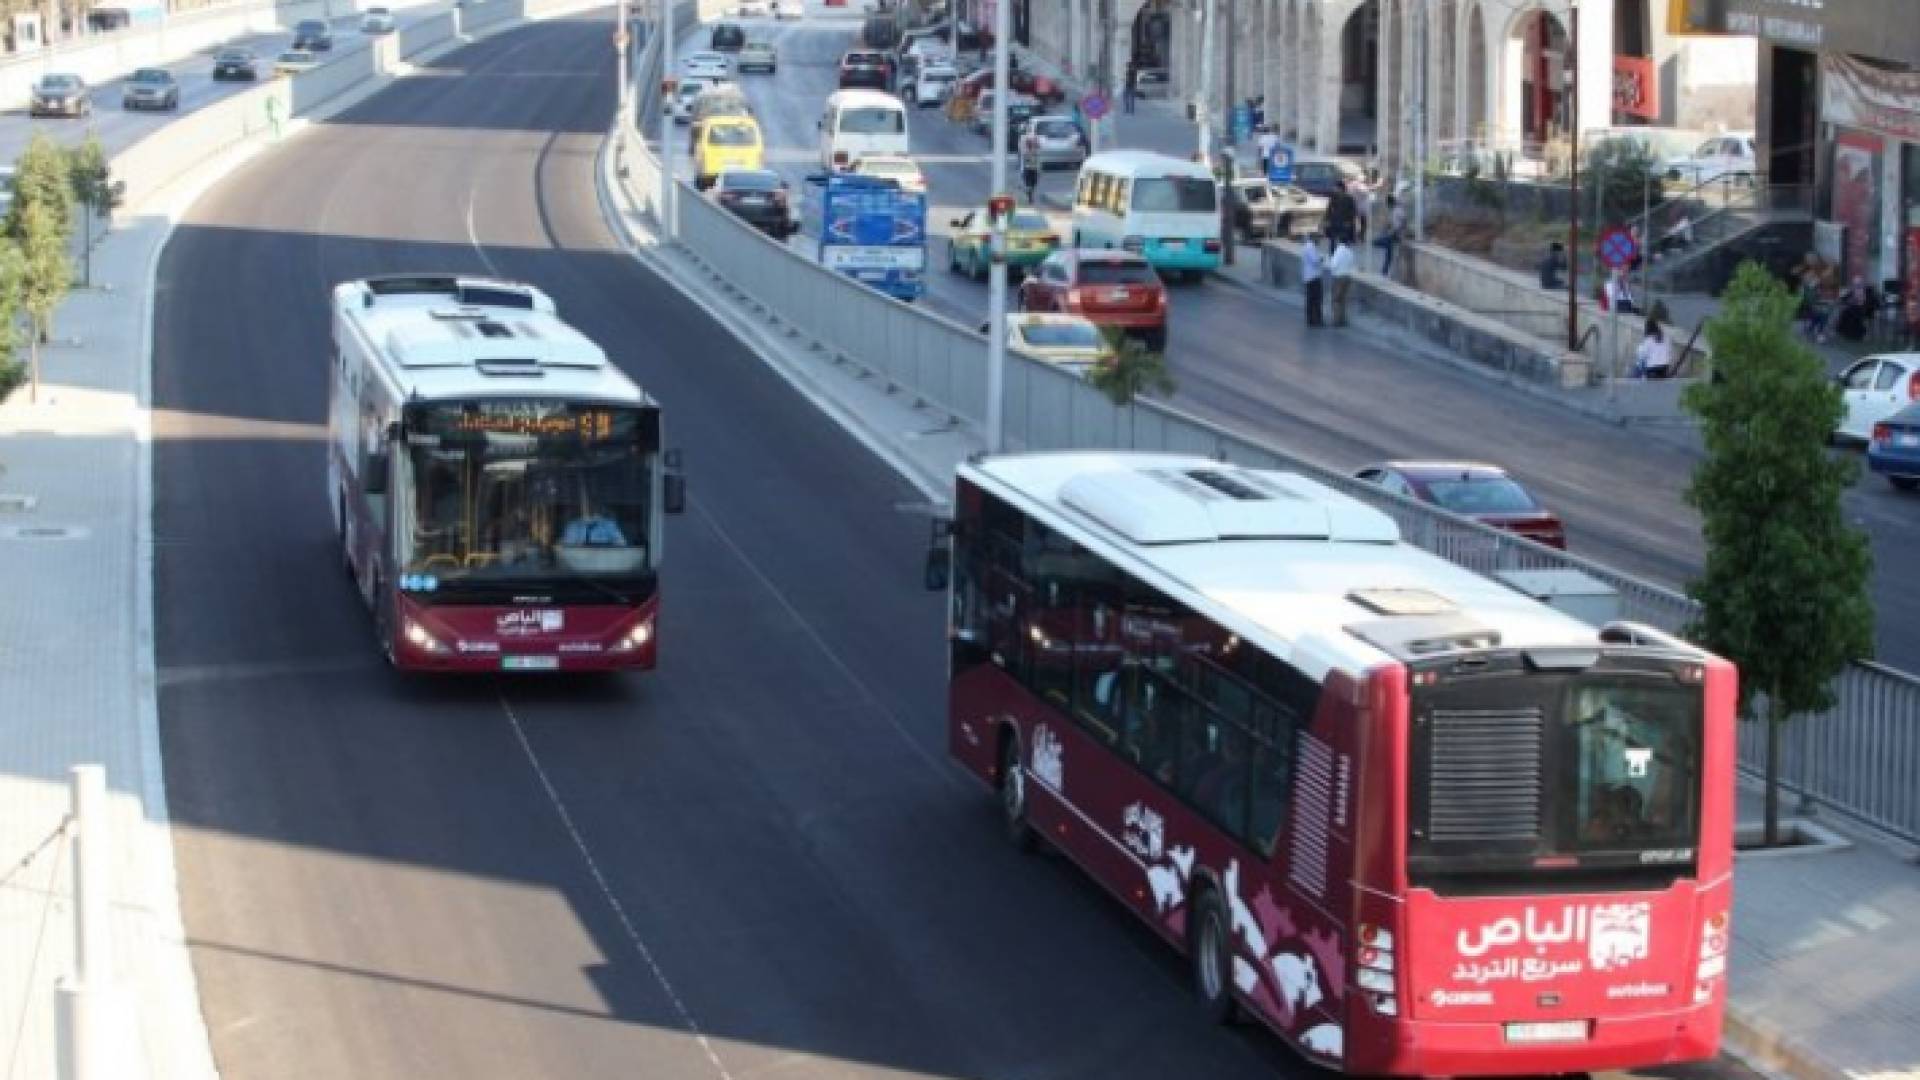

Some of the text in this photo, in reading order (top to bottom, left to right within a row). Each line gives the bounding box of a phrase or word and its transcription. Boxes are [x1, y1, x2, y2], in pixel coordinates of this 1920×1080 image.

[1457, 905, 1586, 955] الباص
[1453, 956, 1582, 983] سريع التردد
